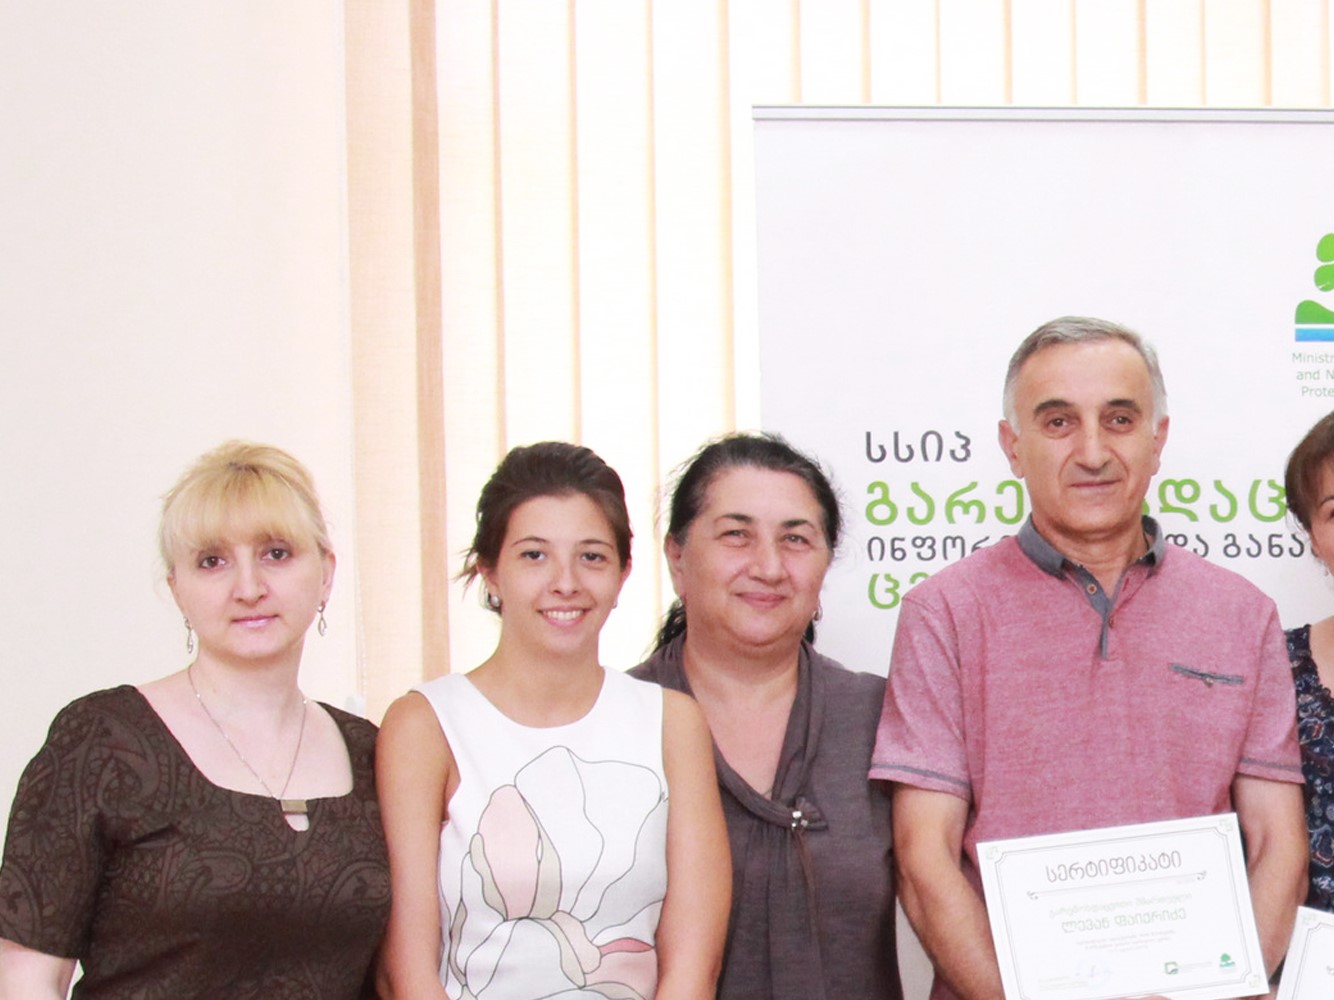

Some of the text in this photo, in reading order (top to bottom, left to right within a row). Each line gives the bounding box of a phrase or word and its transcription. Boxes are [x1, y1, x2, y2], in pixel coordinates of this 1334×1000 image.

[1296, 369, 1320, 381] and
[865, 430, 972, 463] სსიპ
[1045, 850, 1183, 883] სერტიფიკატი
